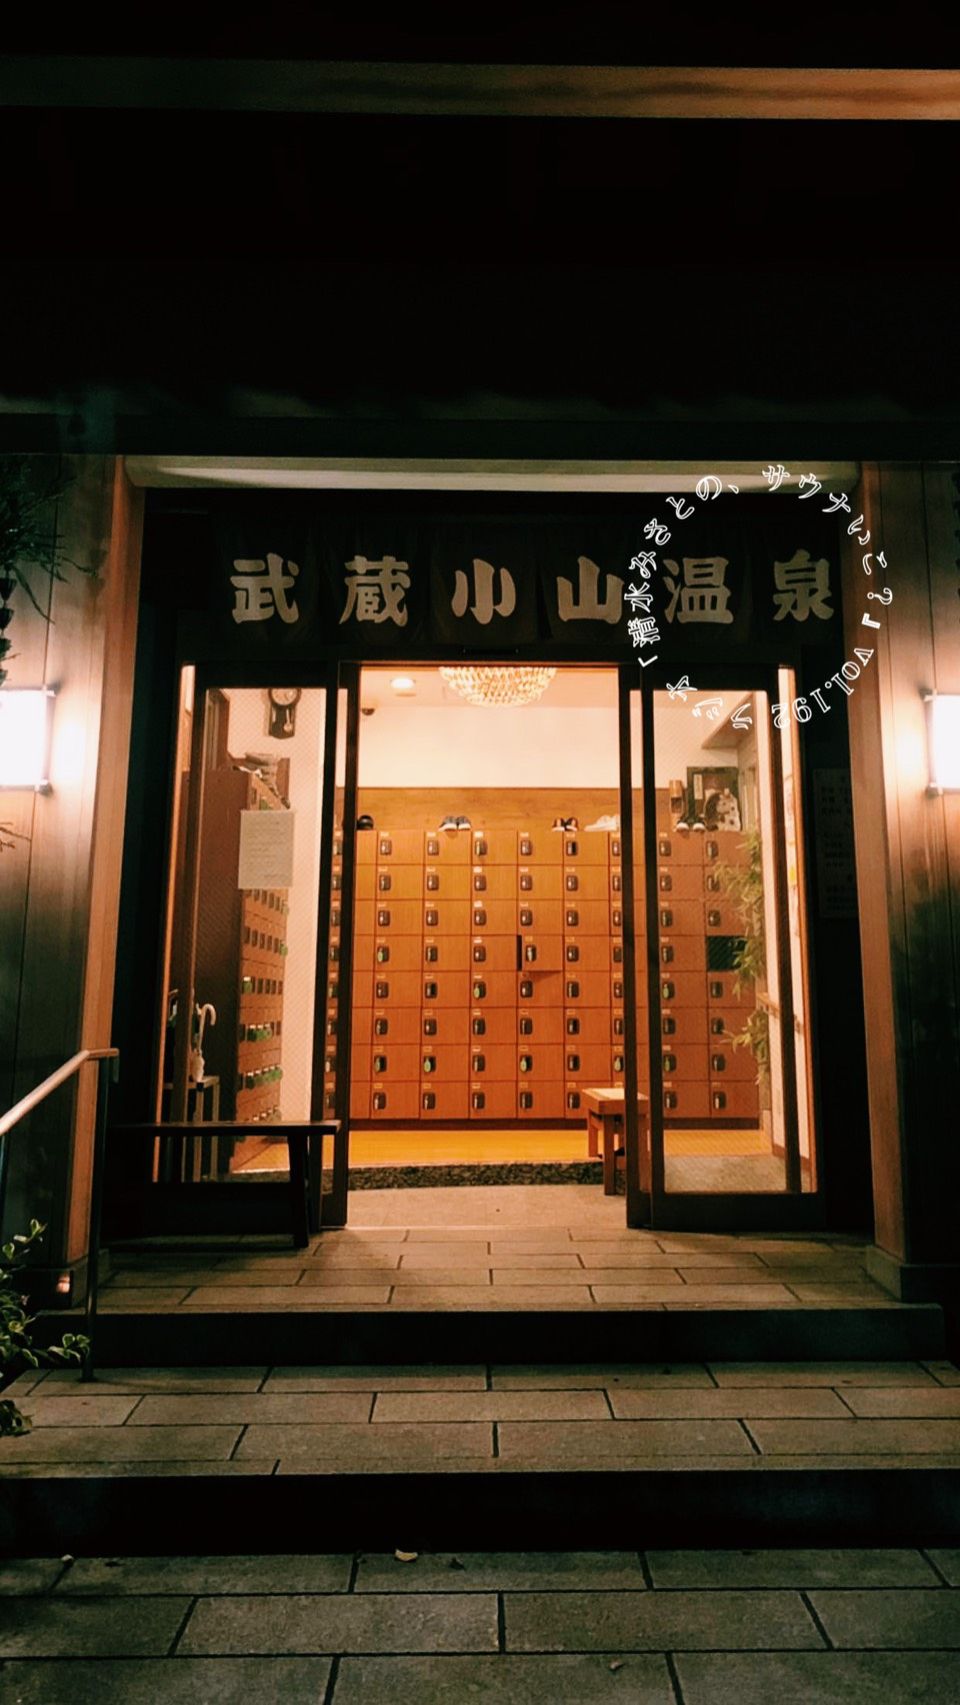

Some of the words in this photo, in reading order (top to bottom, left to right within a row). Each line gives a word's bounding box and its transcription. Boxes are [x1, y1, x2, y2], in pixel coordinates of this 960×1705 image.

[231, 549, 834, 625] 武蔵小山温泉
